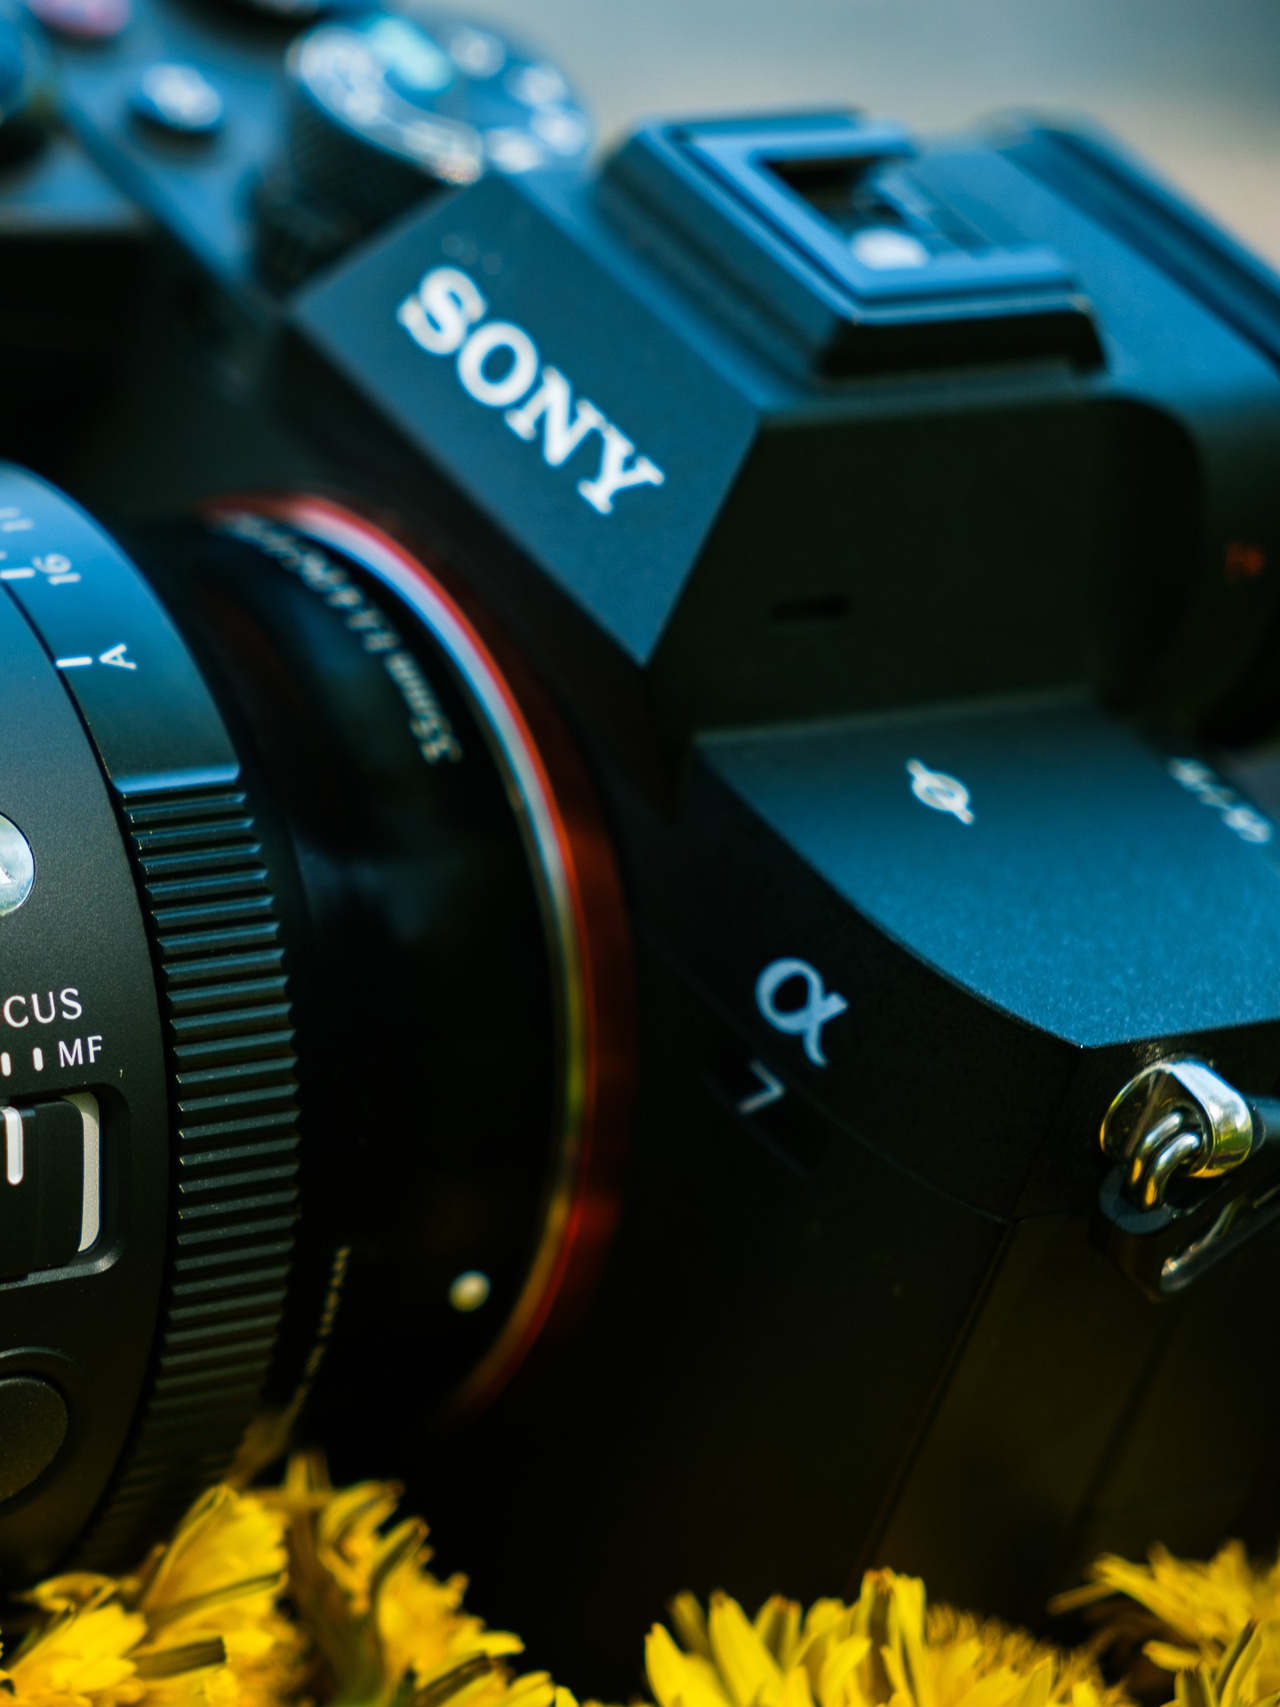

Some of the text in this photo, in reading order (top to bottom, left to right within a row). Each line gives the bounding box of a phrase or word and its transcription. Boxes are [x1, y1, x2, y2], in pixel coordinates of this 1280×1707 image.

[399, 266, 666, 514] SONY
[31, 553, 82, 587] 16
[98, 643, 138, 671] A
[58, 1035, 104, 1068] MF
[736, 1062, 786, 1116] 7
